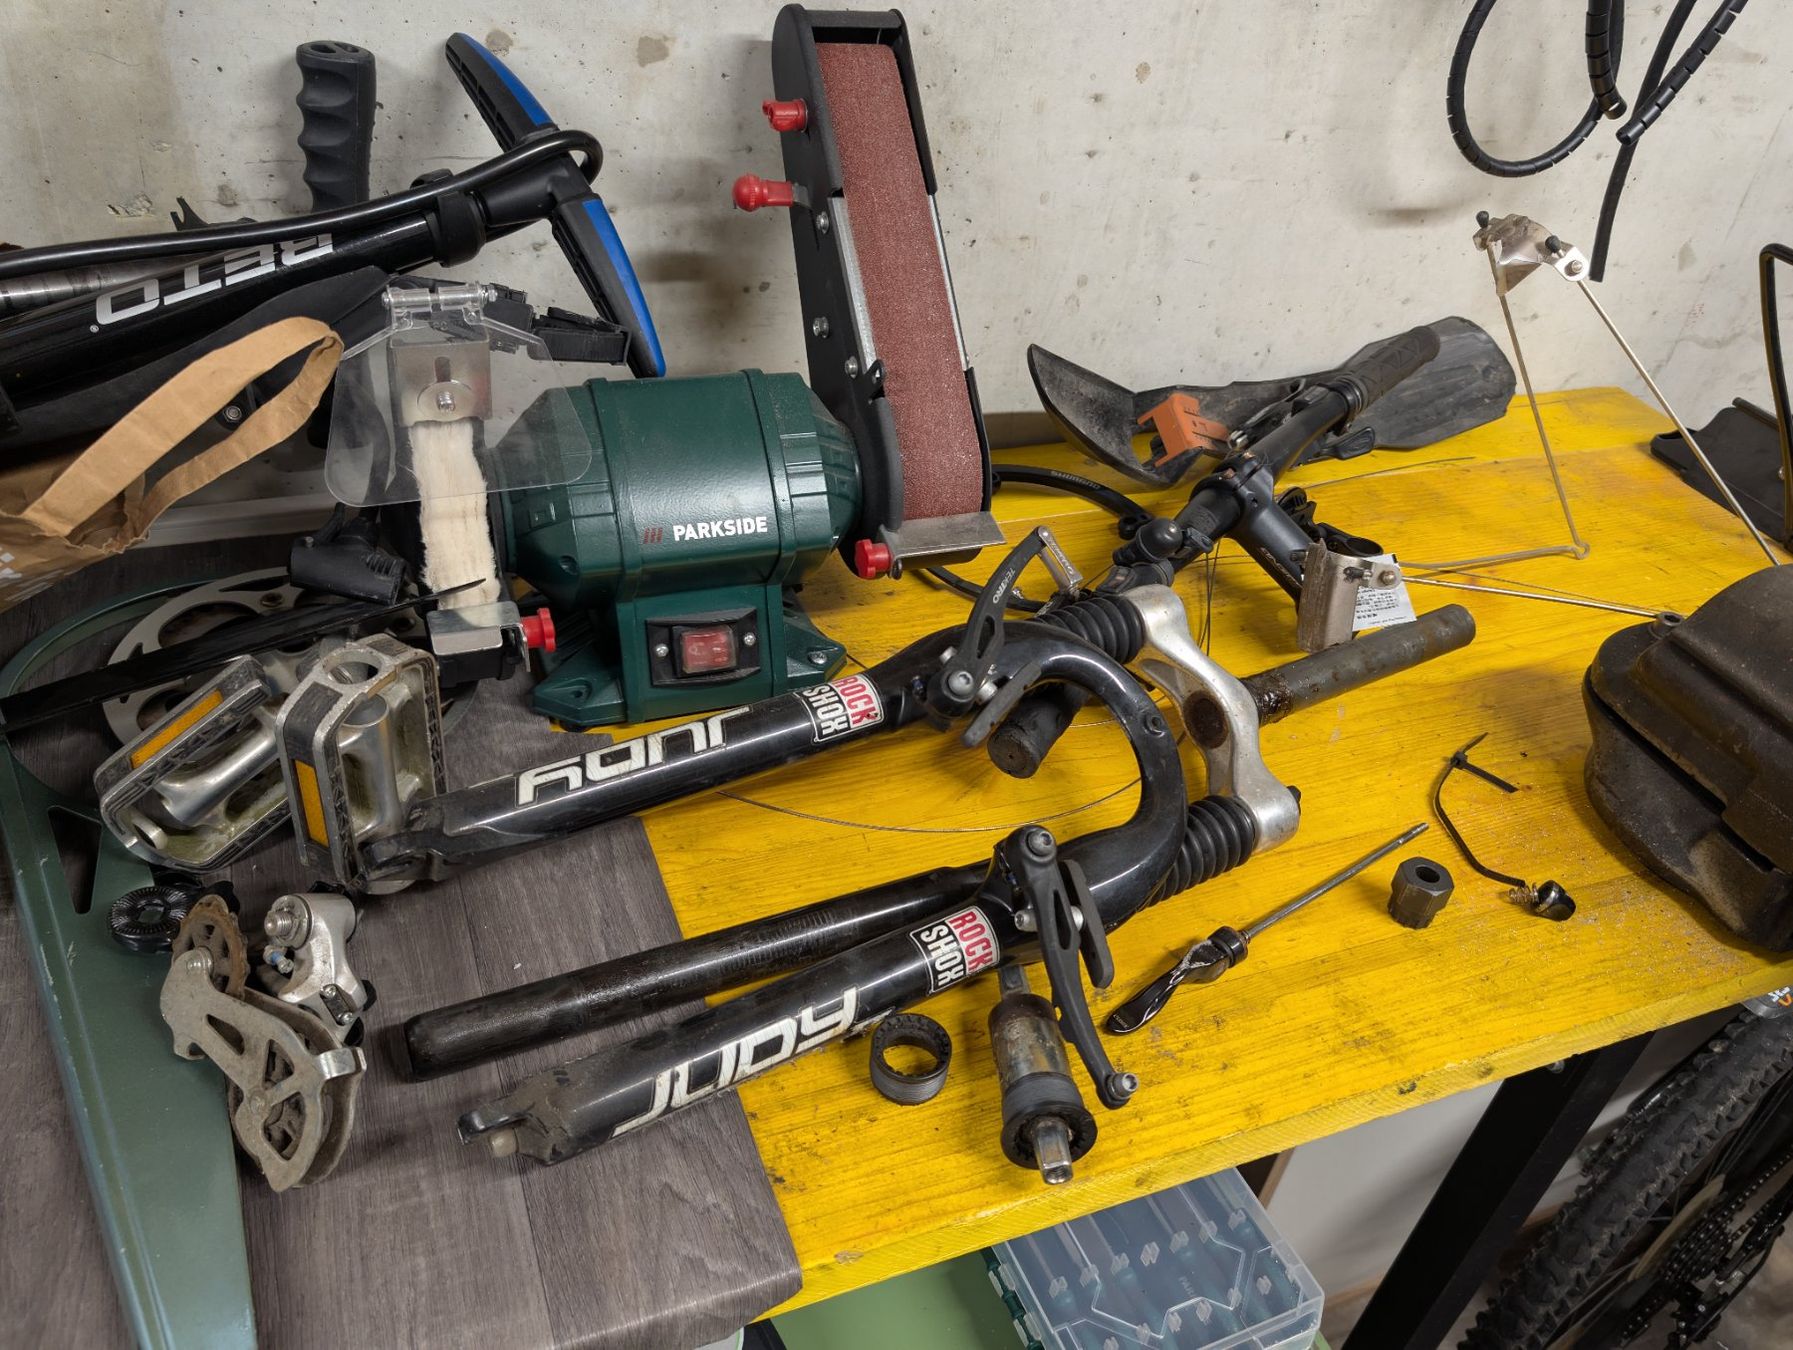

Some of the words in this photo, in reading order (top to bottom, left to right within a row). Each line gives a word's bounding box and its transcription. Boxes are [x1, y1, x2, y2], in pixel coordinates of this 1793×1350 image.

[96, 233, 333, 325] BETO
[672, 516, 768, 541] PARKSIDE
[992, 567, 1015, 604] TEKTRO
[803, 685, 848, 735] SHOX
[832, 676, 876, 724] ROCK
[519, 706, 749, 805] JUDY
[920, 924, 965, 986] SHOX
[949, 911, 992, 971] ROCK
[612, 986, 856, 1138] JUDY
